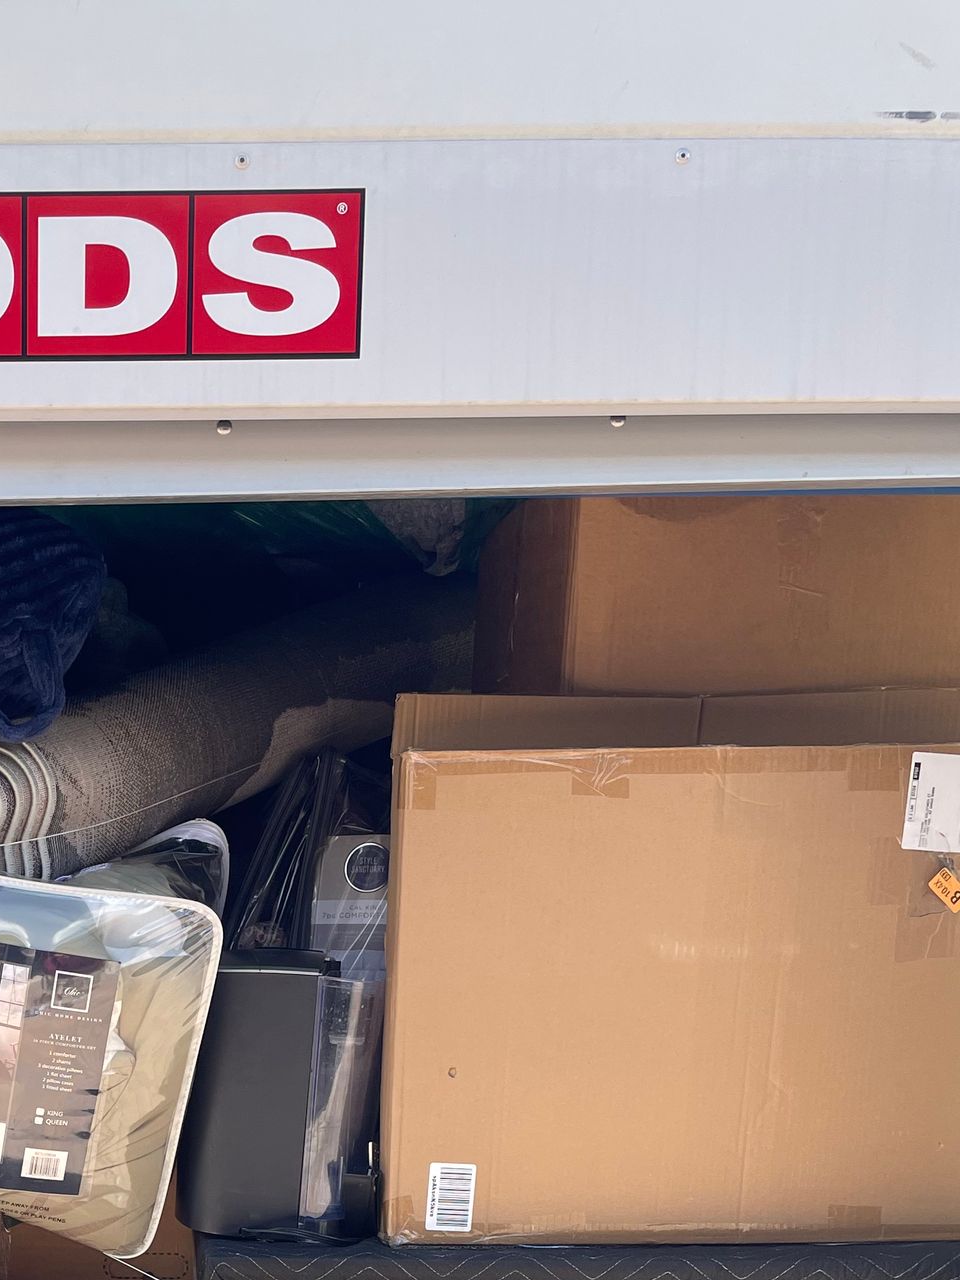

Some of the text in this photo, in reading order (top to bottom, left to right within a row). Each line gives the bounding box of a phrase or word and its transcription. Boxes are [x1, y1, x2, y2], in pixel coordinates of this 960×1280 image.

[359, 857, 377, 865] STYLE
[351, 865, 385, 874] SANCTUARY
[49, 1033, 82, 1043] AYELET
[55, 1041, 86, 1049] COMFORTER
[53, 1051, 77, 1059] comforter
[42, 1063, 66, 1071] decorative
[11, 1202, 29, 1210] AWAY
[48, 1216, 66, 1224] PENS
